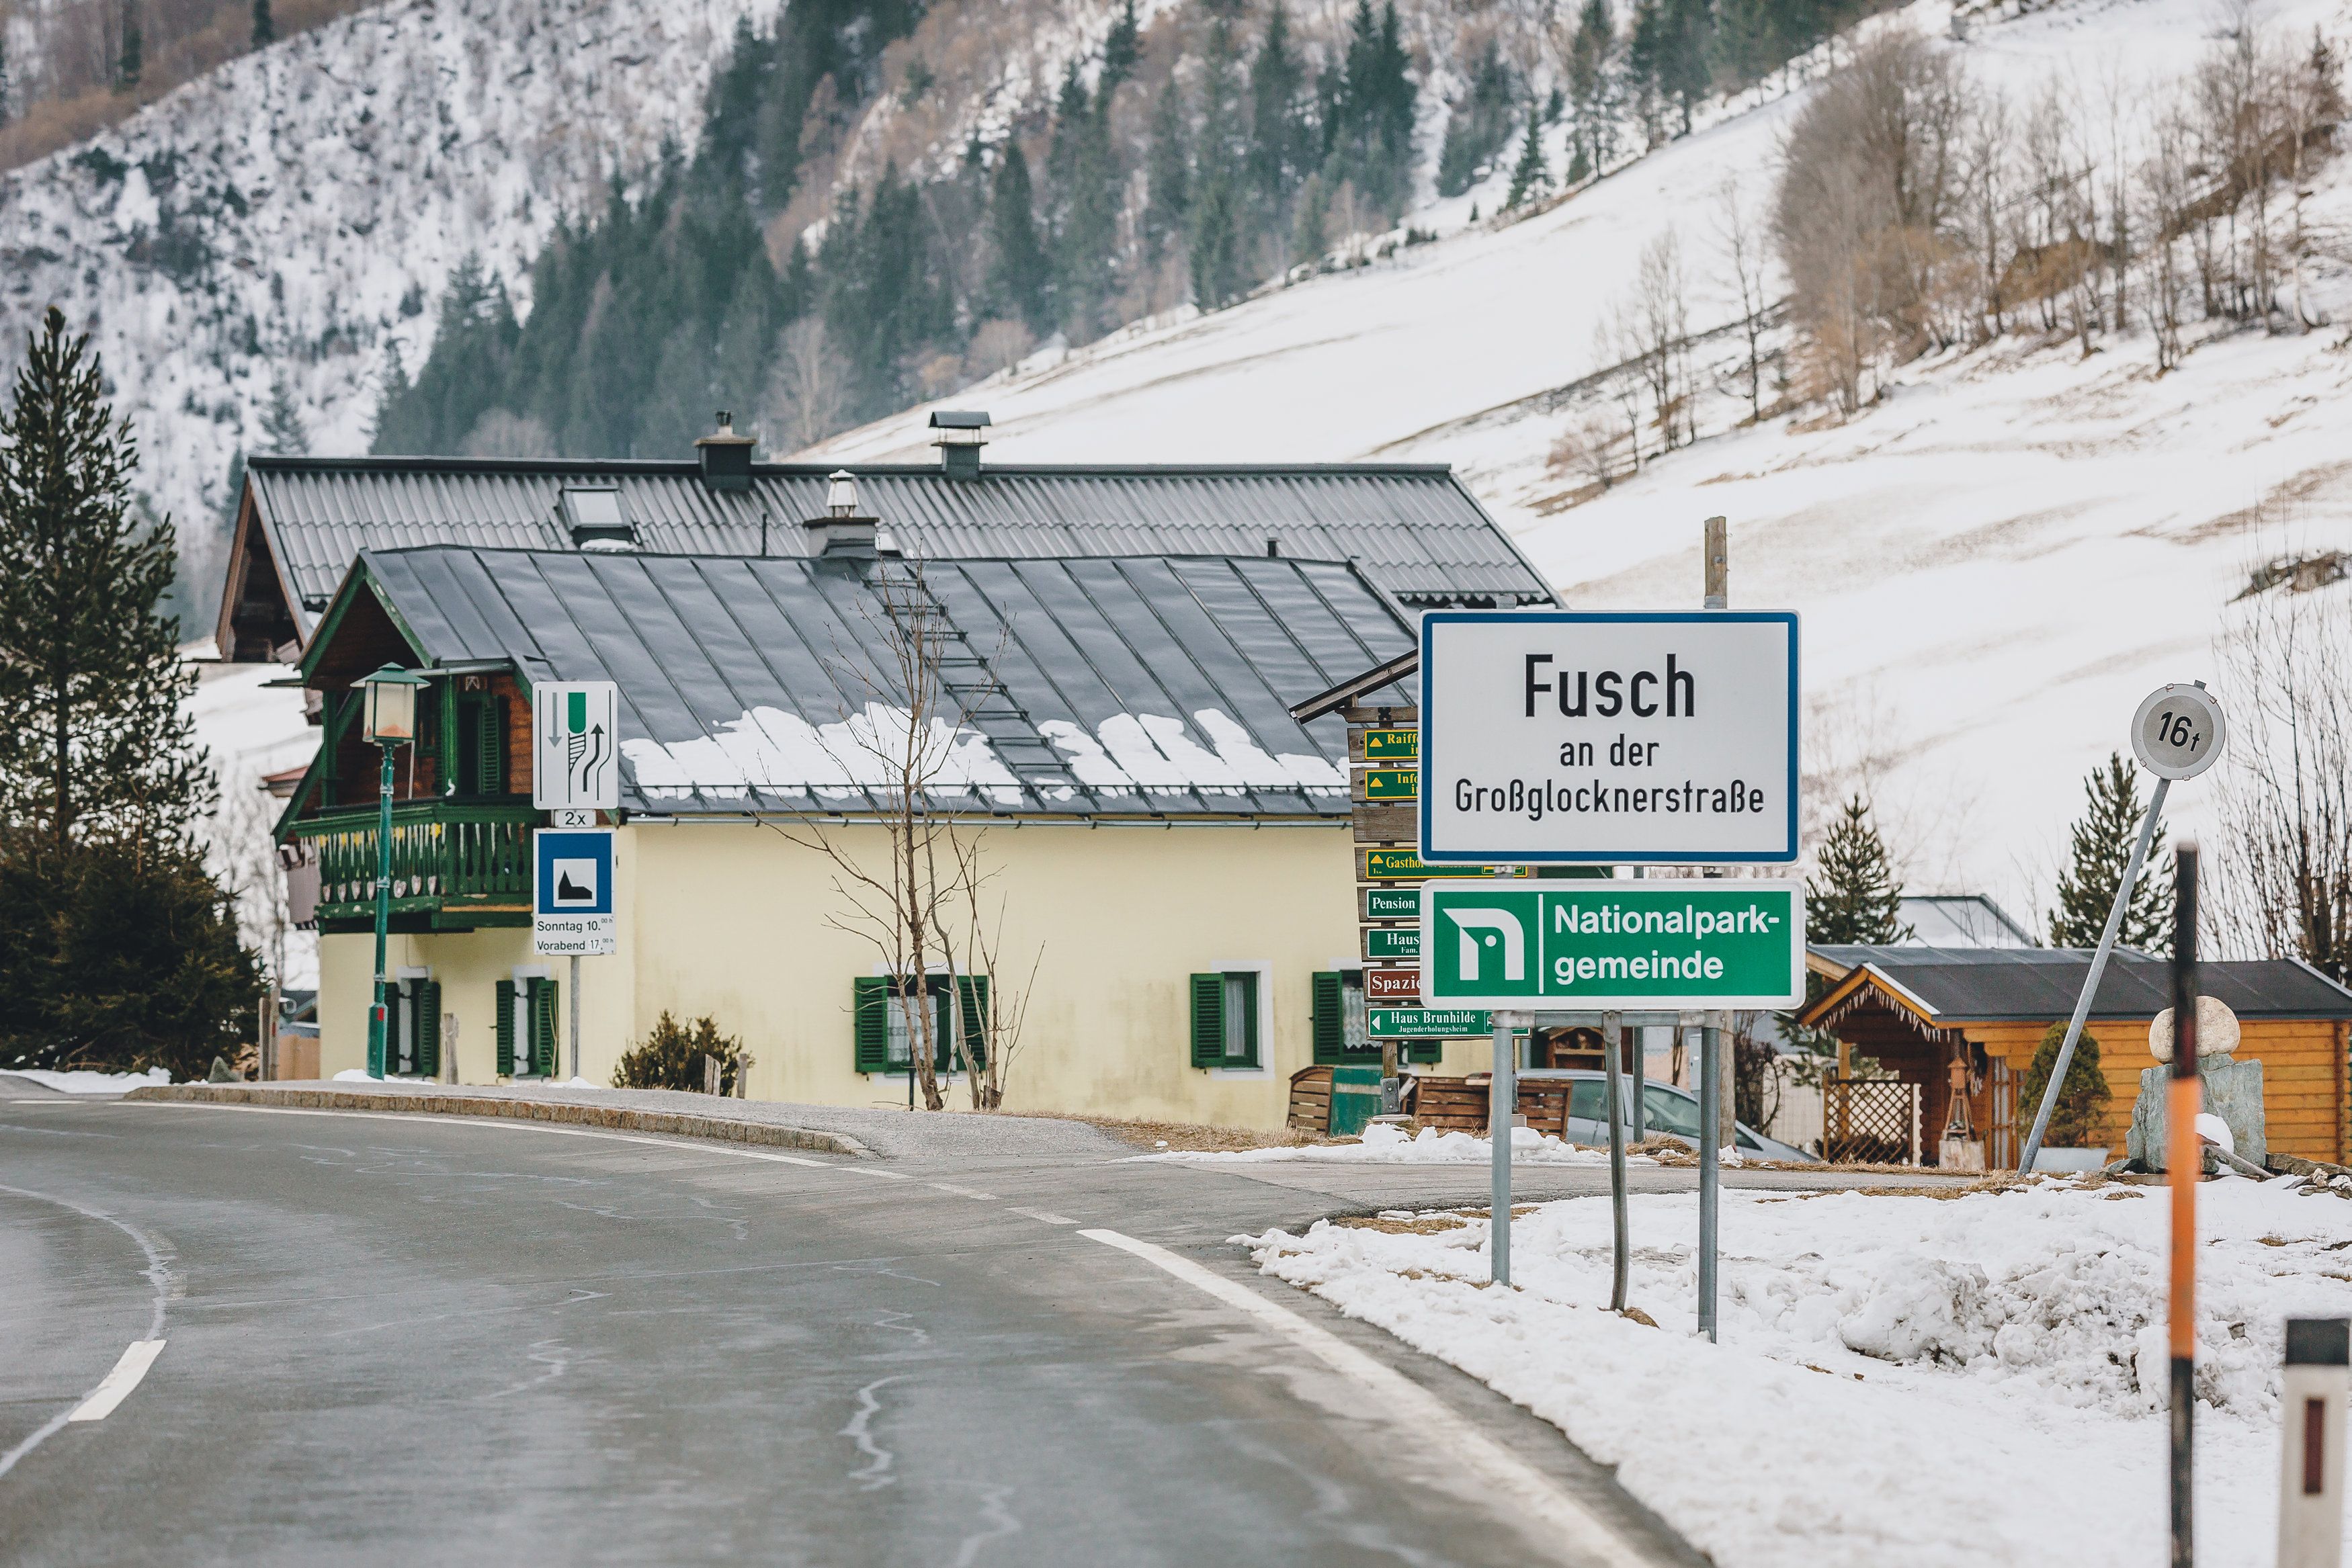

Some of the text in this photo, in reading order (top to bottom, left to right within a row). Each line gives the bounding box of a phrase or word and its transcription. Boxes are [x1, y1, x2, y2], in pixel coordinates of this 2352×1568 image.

[1525, 654, 1695, 717] Fusch
[1387, 733, 1418, 744] Raiff
[1560, 733, 1660, 767] an der
[1456, 778, 1765, 822] Großglocknerstraße
[565, 812, 586, 825] 2x
[1372, 897, 1415, 910] Pension
[537, 920, 583, 933] Sonntag
[1554, 904, 1780, 940] Nationalpark-
[1386, 932, 1419, 945] Haus
[537, 941, 585, 951] Vorabend
[1554, 949, 1724, 986] gemeinde
[1391, 1010, 1476, 1024] Haus Brunhilde
[1398, 1025, 1468, 1033] Jugenderholungsheim
